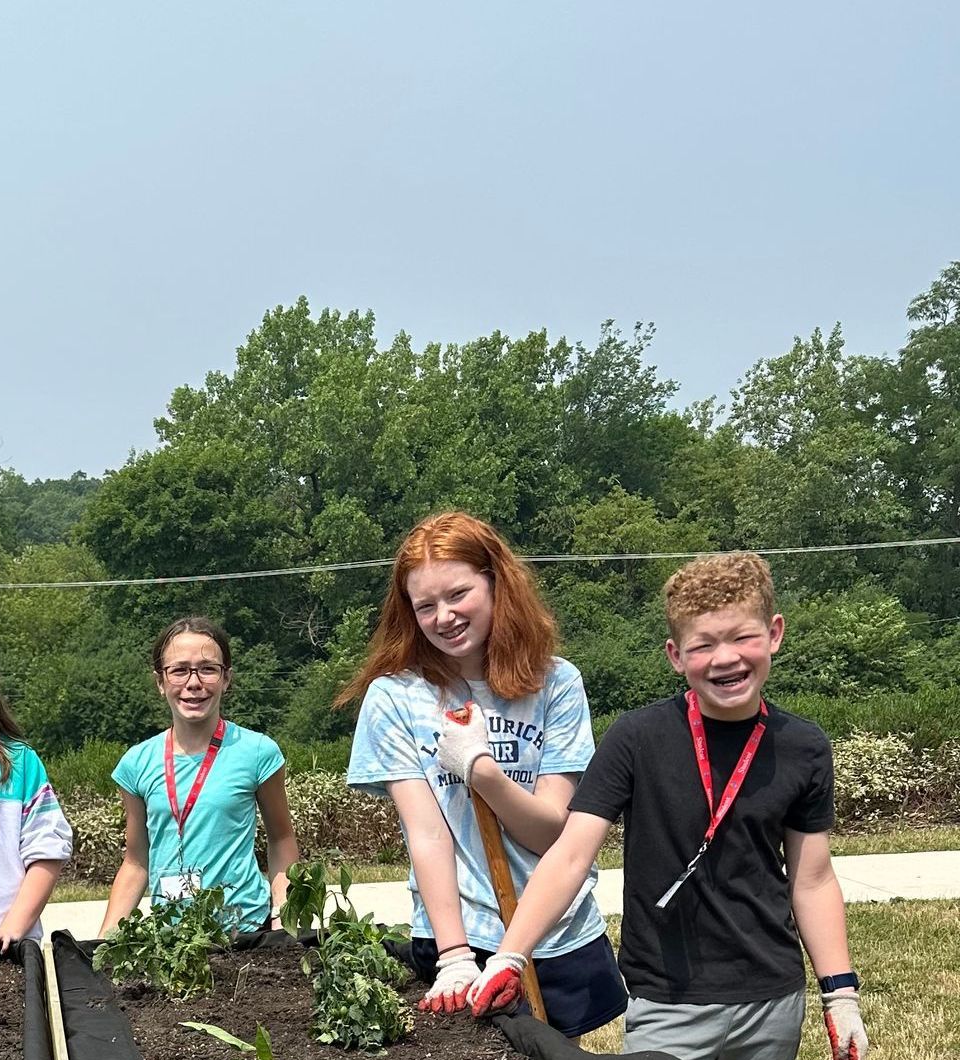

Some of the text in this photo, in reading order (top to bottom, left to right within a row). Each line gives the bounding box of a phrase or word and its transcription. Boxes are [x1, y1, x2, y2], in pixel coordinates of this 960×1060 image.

[488, 716, 544, 750] URICH
[737, 751, 753, 774] Student
[503, 769, 534, 784] HOOL
